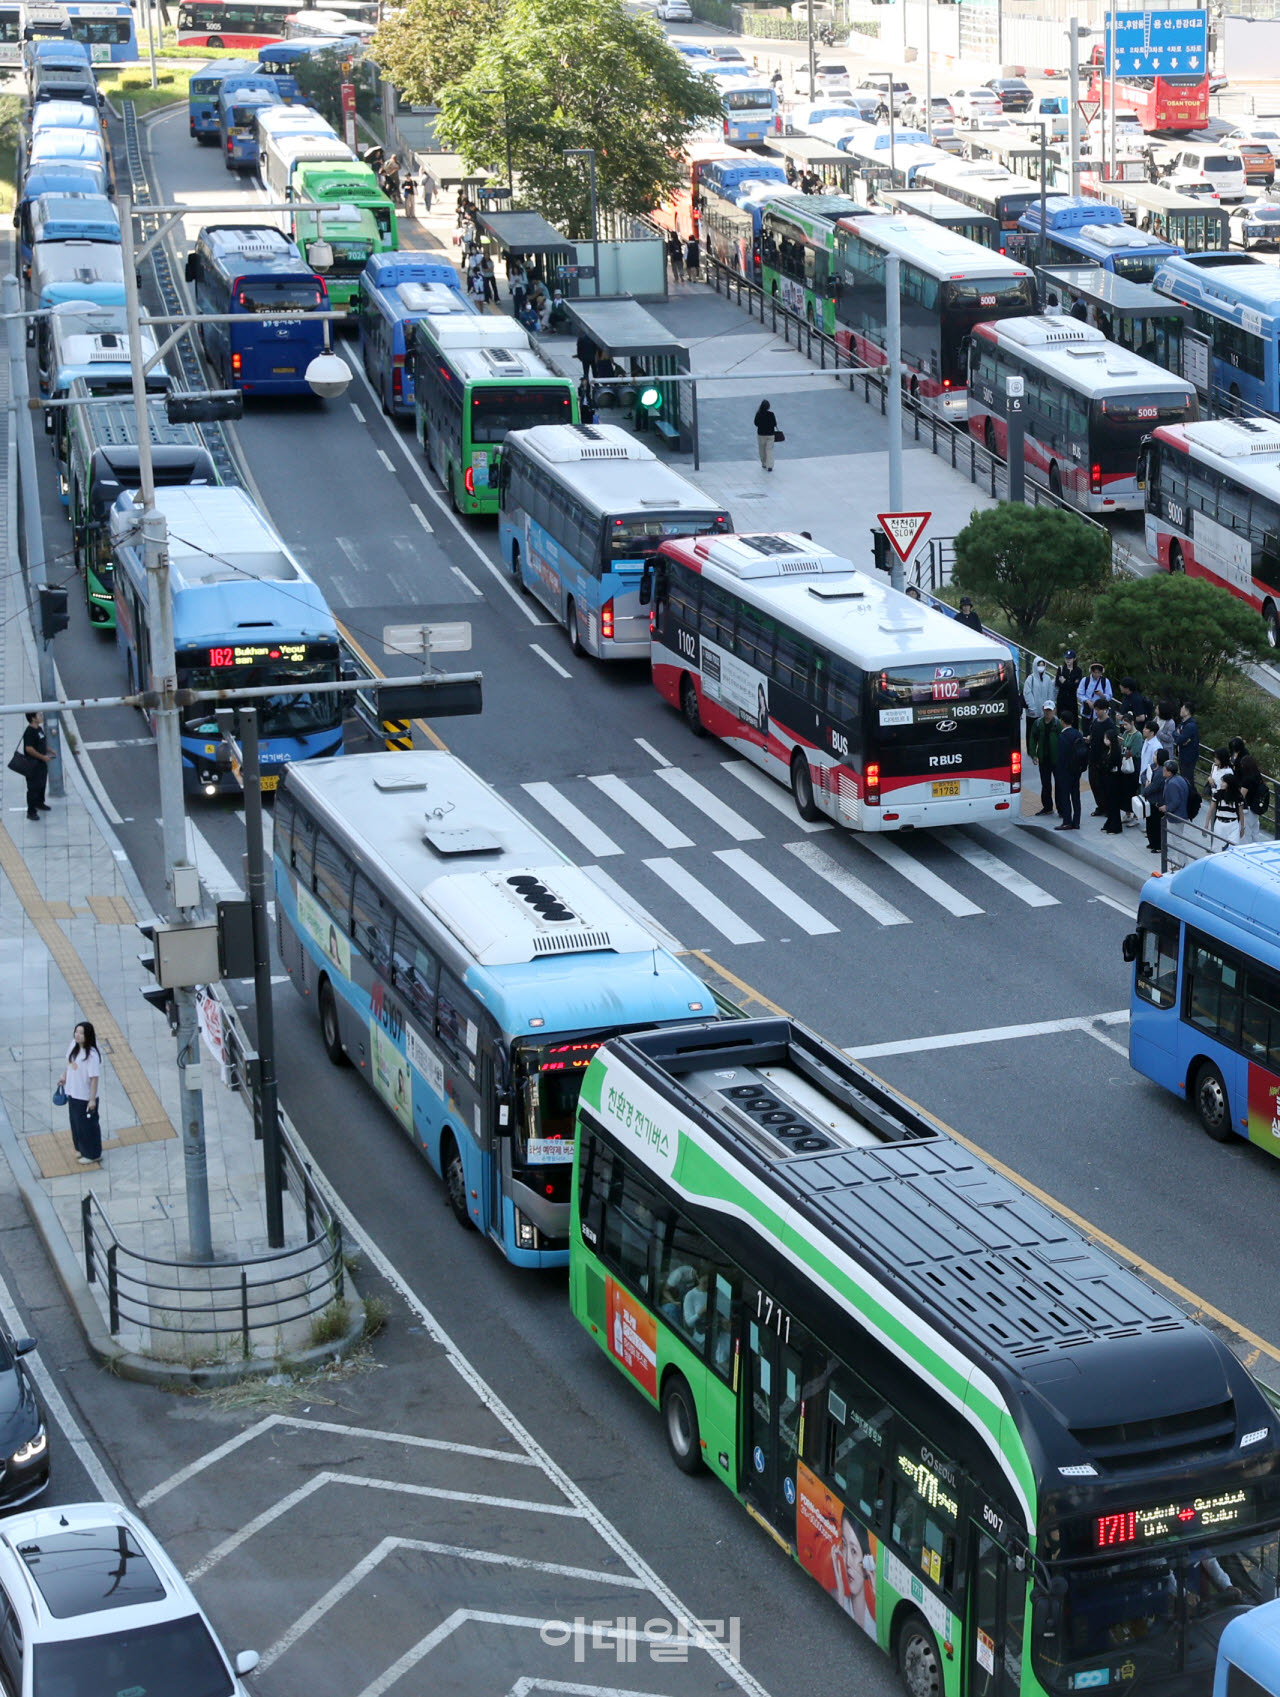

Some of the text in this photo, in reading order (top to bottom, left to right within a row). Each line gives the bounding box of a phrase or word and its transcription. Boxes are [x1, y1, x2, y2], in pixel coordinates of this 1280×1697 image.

[348, 251, 366, 261] 7024
[980, 295, 996, 306] 5000
[1013, 399, 1021, 409] 6
[1137, 407, 1158, 418] 5005
[891, 518, 918, 529] 천천히
[894, 529, 914, 537] SLOW
[677, 628, 696, 659] 1102
[208, 647, 234, 667] 162
[234, 646, 269, 656] Bukhan
[933, 682, 959, 698] 1102
[831, 729, 849, 756] BUS
[939, 753, 963, 766] BUS
[939, 786, 959, 796] 1782
[608, 1086, 670, 1158] 친환경 전기버스
[757, 1289, 791, 1344] 1711
[933, 1459, 957, 1489] SEOUL
[983, 1504, 1004, 1533] 5007
[1097, 1511, 1136, 1546] 1711
